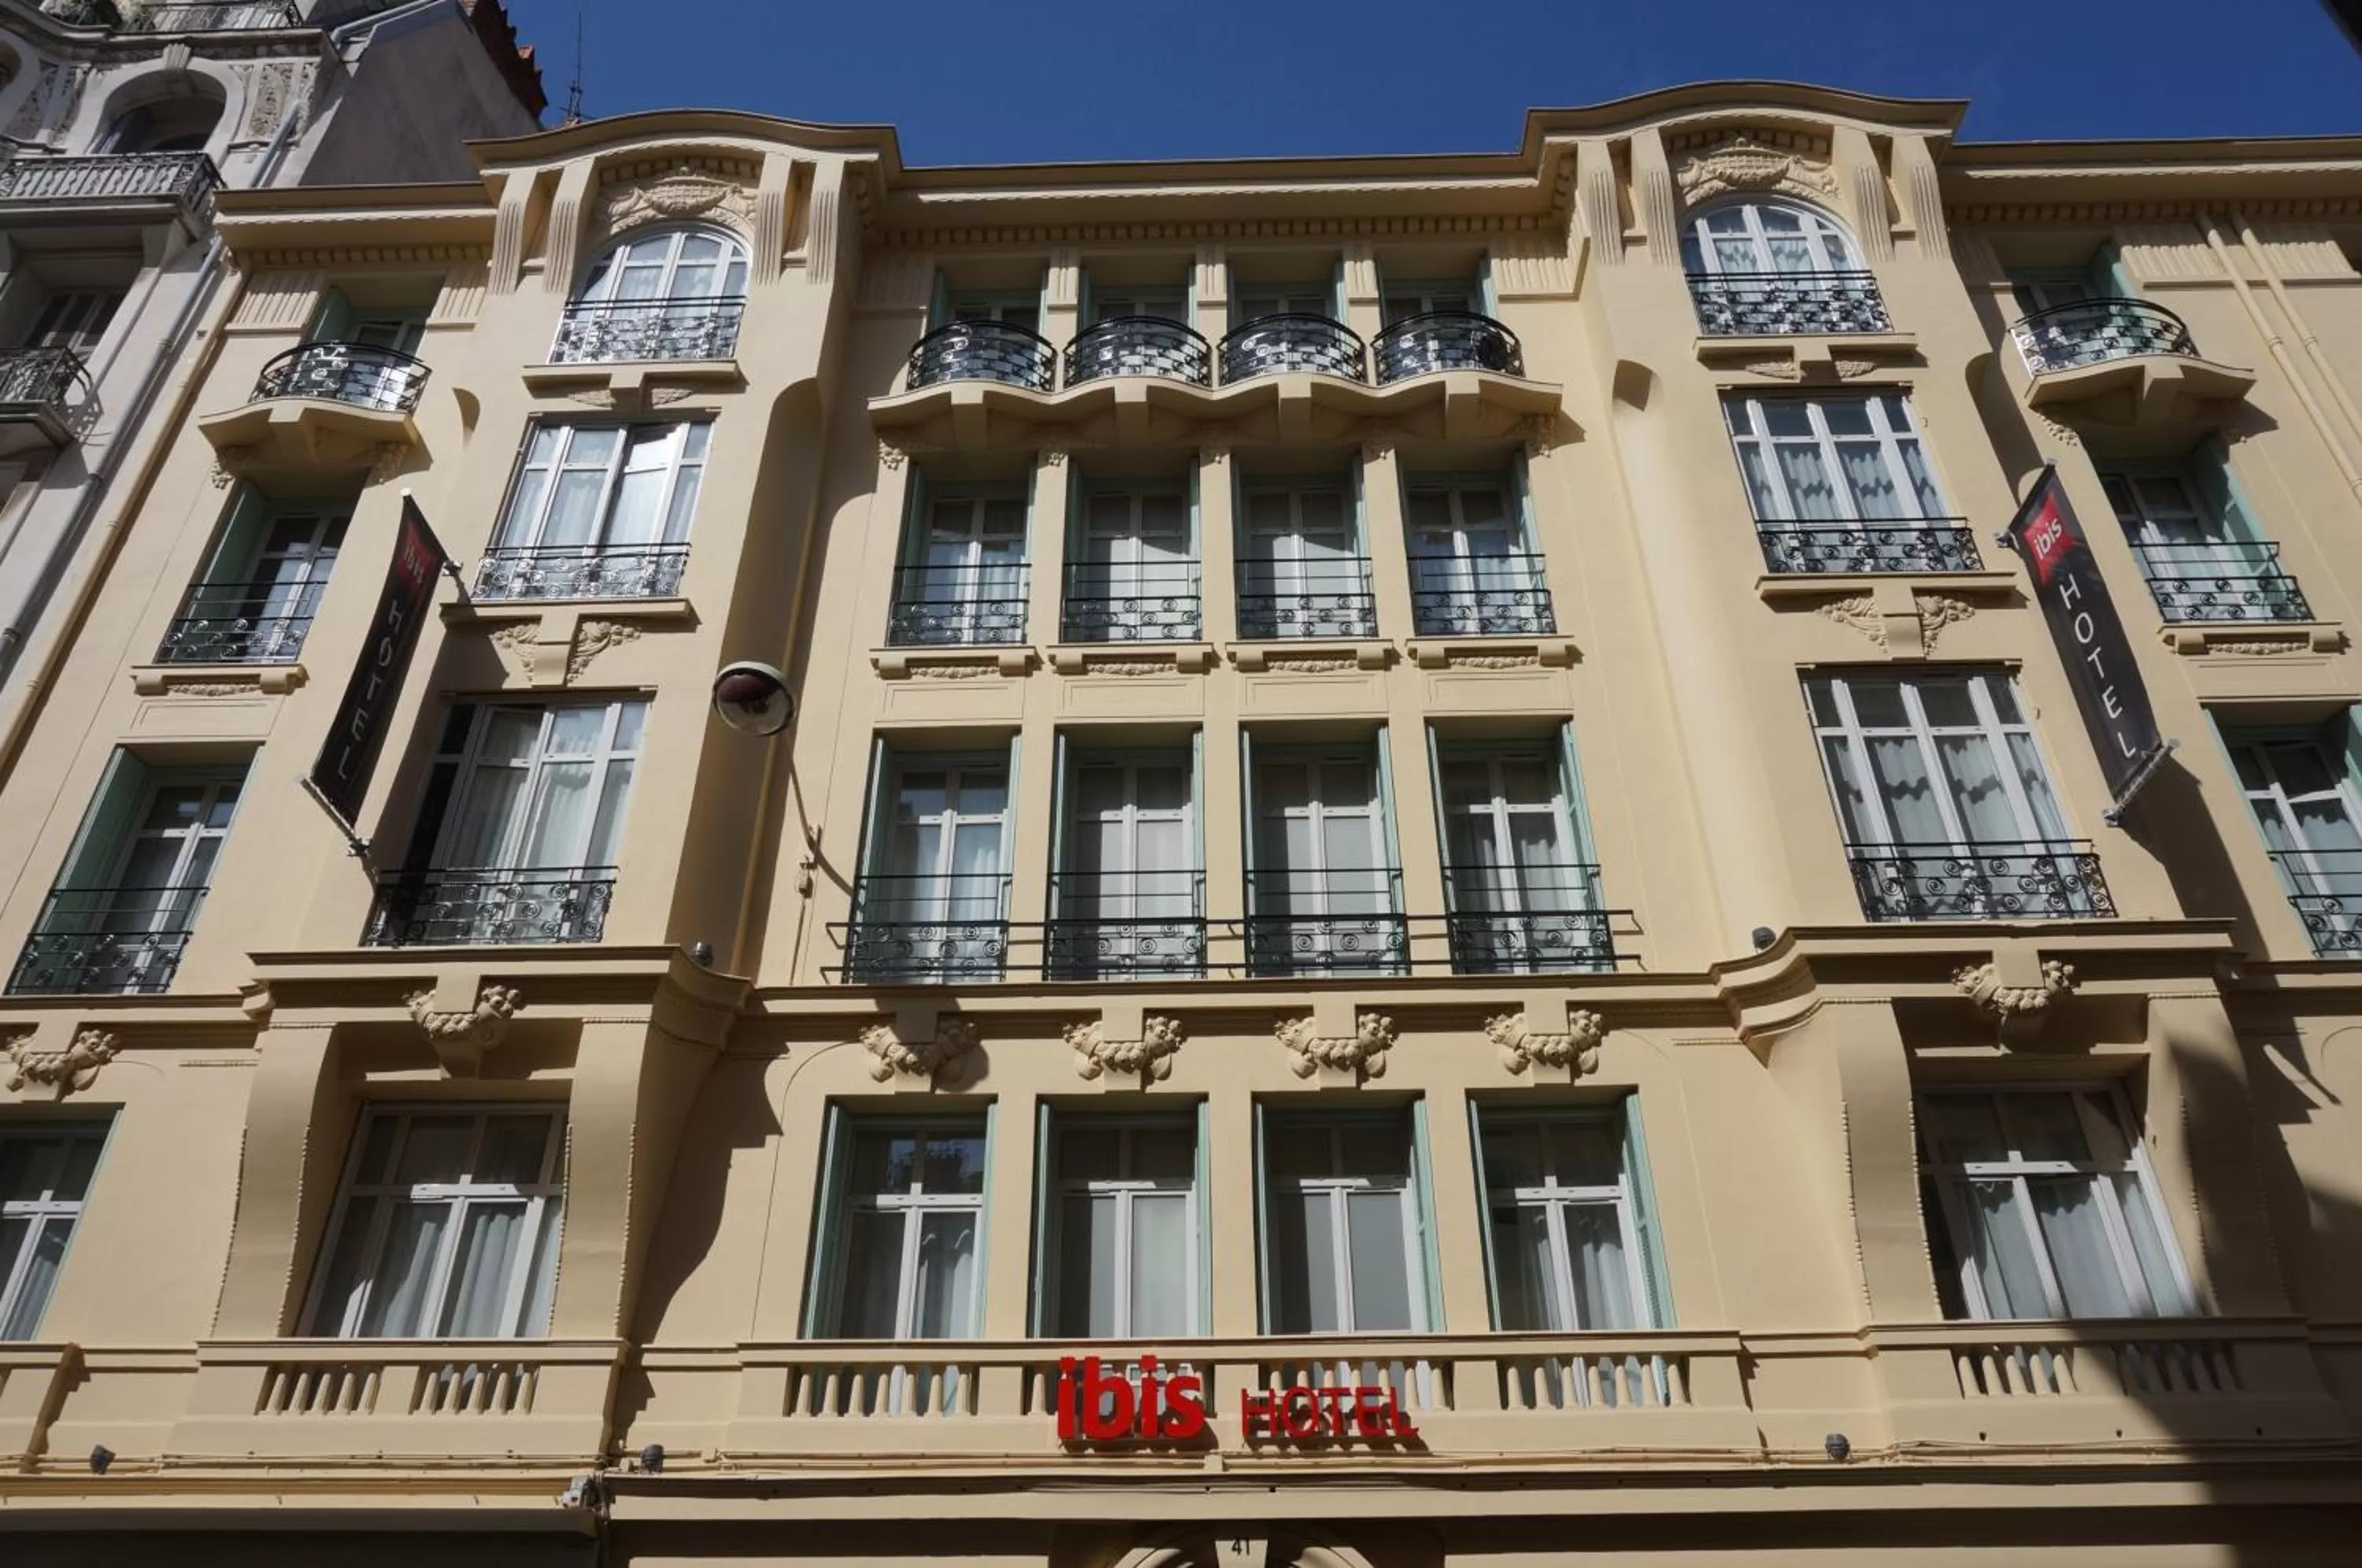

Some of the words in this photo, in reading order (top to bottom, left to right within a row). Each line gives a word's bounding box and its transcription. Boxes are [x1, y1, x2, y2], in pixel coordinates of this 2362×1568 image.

[2033, 516, 2063, 561] ibis
[338, 598, 403, 780] HOTEL
[2059, 574, 2137, 759] HOTEL
[1057, 1354, 1206, 1440] ibis
[1242, 1385, 1420, 1437] HOTEL
[1231, 1537, 1250, 1556] 41
